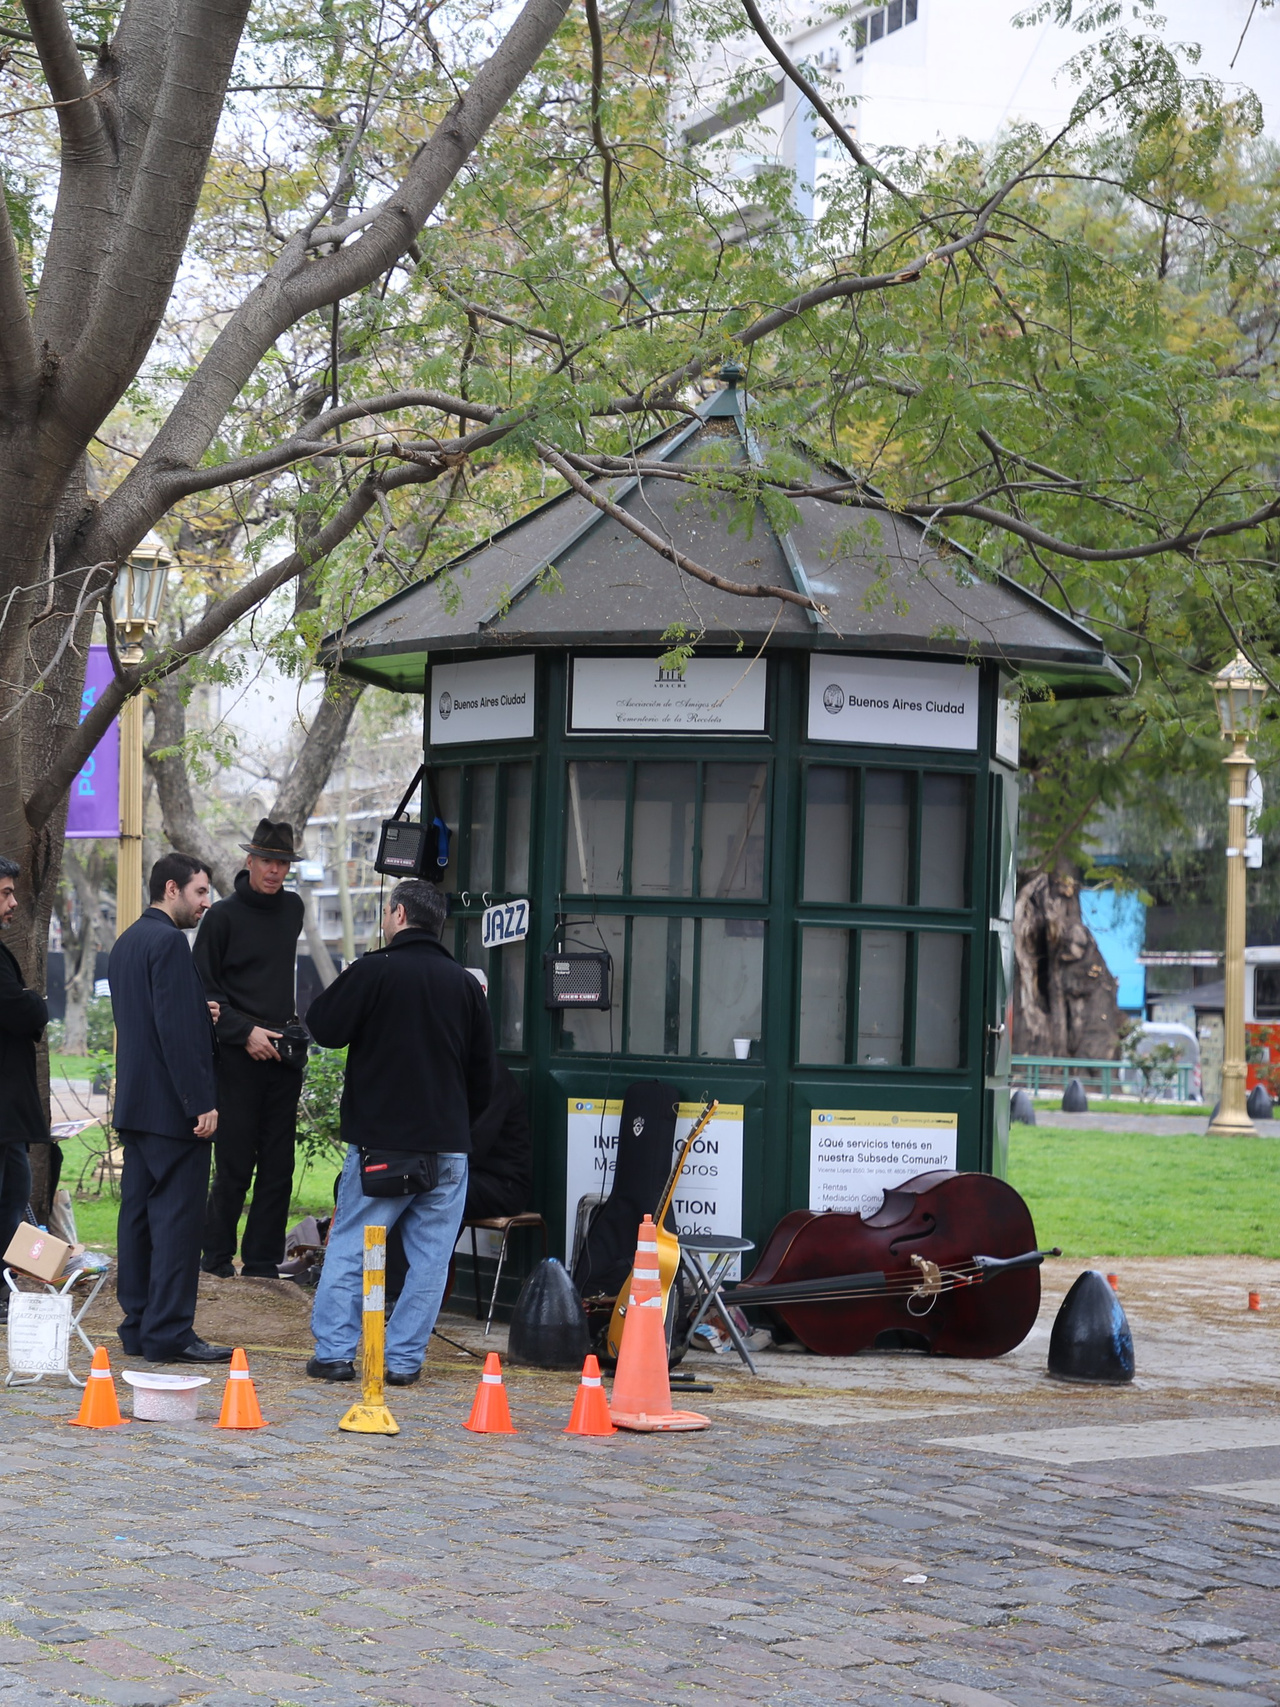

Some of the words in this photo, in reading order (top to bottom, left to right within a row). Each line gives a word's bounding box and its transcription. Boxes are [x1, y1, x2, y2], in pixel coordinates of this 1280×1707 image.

[453, 699, 479, 711] Buenos
[480, 697, 499, 708] Aires
[500, 693, 526, 706] Ciudad
[616, 698, 662, 708] Asociación
[663, 699, 672, 708] de
[674, 699, 710, 709] Amigos
[848, 695, 889, 709] Buenos
[892, 698, 923, 711] Aires
[925, 701, 965, 714] Ciudad
[615, 712, 659, 723] Cementerio
[662, 714, 671, 723] de
[674, 713, 682, 723] la
[686, 712, 722, 723] Recoleta
[484, 903, 526, 943] JAZZ
[817, 1137, 844, 1149] ¿Qué
[846, 1138, 889, 1149] servicios
[891, 1139, 918, 1150] tenés
[920, 1142, 932, 1150] en
[594, 1157, 617, 1171] Ma
[817, 1154, 854, 1163] nuestra
[857, 1153, 899, 1163] Subsede
[901, 1154, 948, 1165] Comunal?
[822, 1183, 848, 1192] Rentas
[822, 1193, 860, 1202] Mediación
[861, 1194, 885, 1203] Comu
